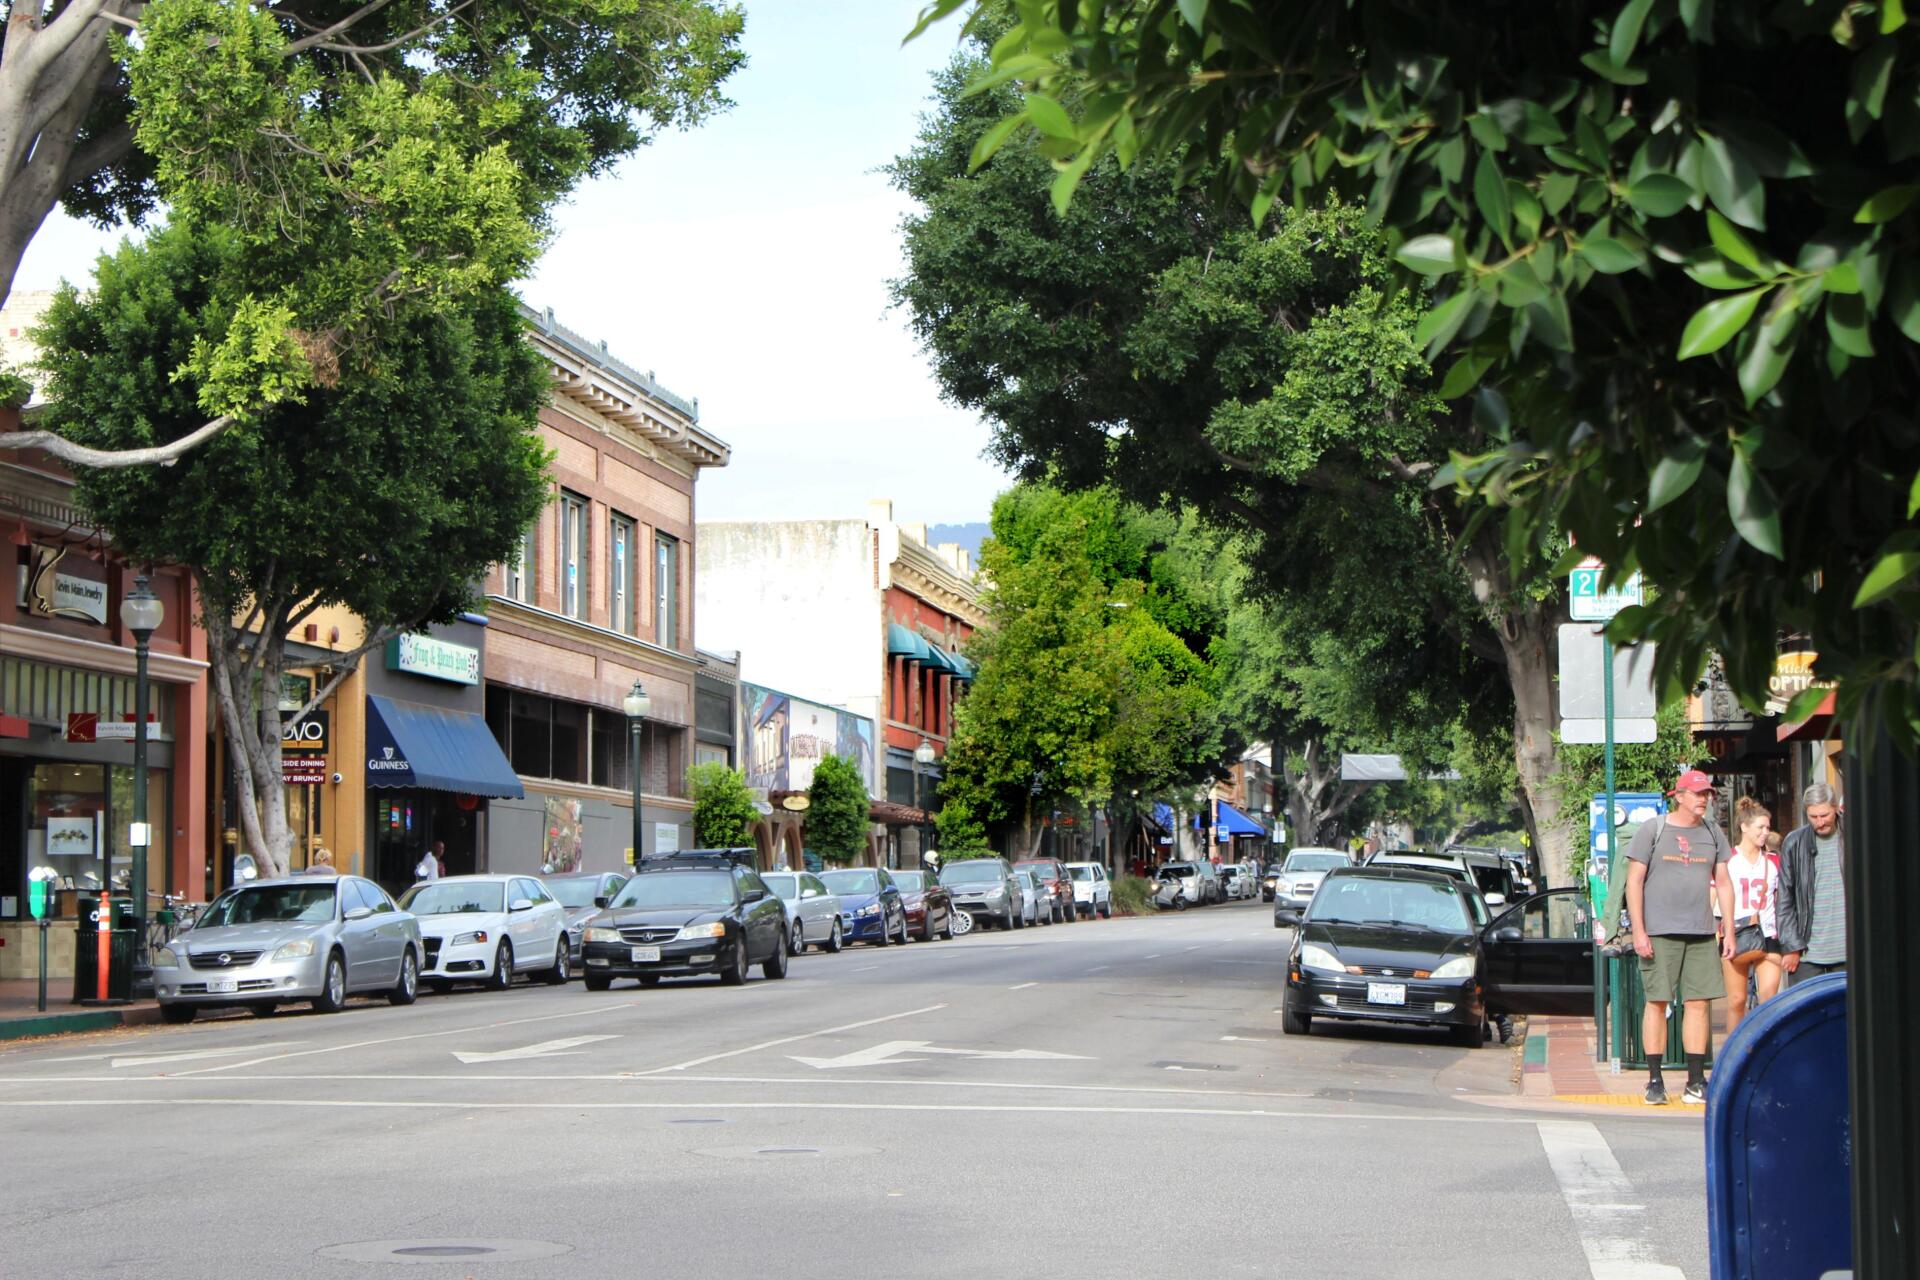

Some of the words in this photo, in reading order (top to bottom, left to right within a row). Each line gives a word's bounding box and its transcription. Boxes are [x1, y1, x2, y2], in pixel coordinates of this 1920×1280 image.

[1578, 573, 1591, 595] 2
[368, 759, 409, 770] GUINNESS
[1739, 877, 1769, 911] 13
